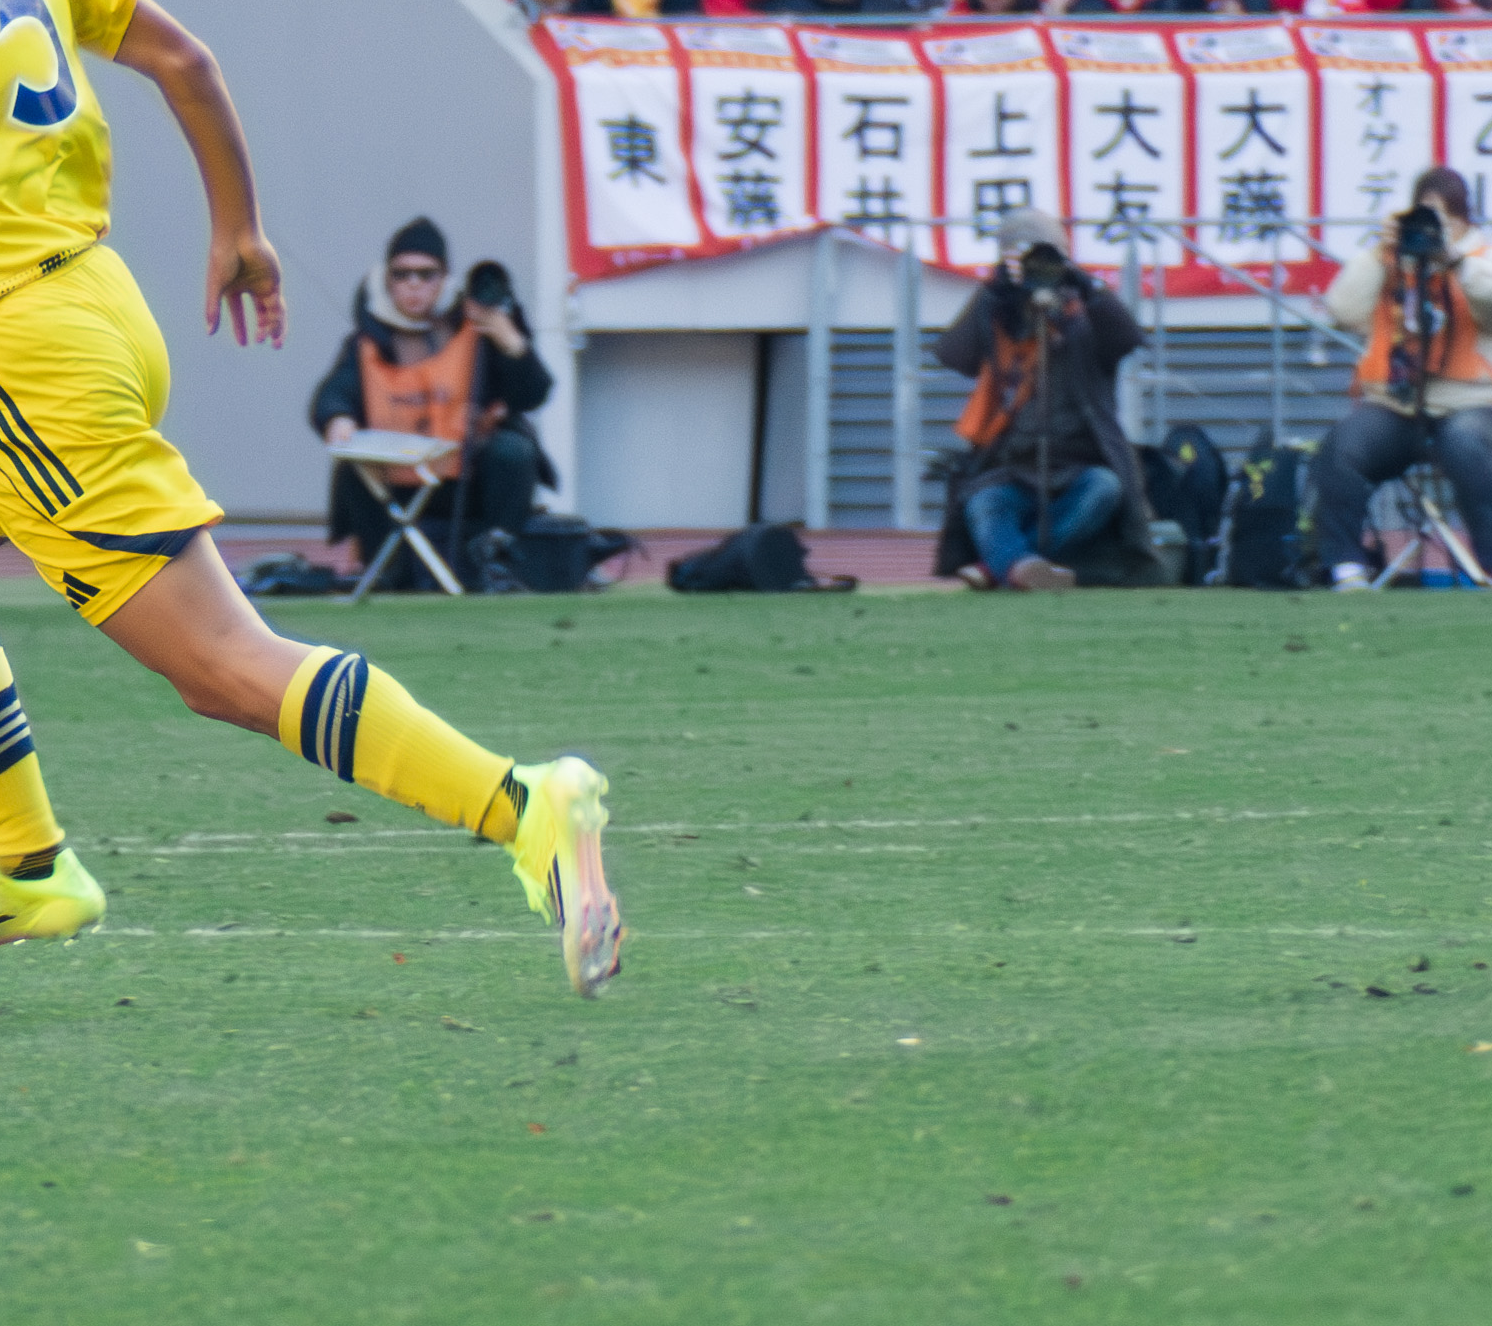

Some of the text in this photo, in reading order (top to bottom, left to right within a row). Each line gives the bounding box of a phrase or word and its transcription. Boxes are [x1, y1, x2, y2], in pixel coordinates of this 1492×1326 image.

[599, 113, 666, 186] 東
[842, 94, 910, 244] 石井
[967, 92, 1031, 241] 上田
[1092, 89, 1162, 243] 大友
[1356, 77, 1399, 247] オゲデ
